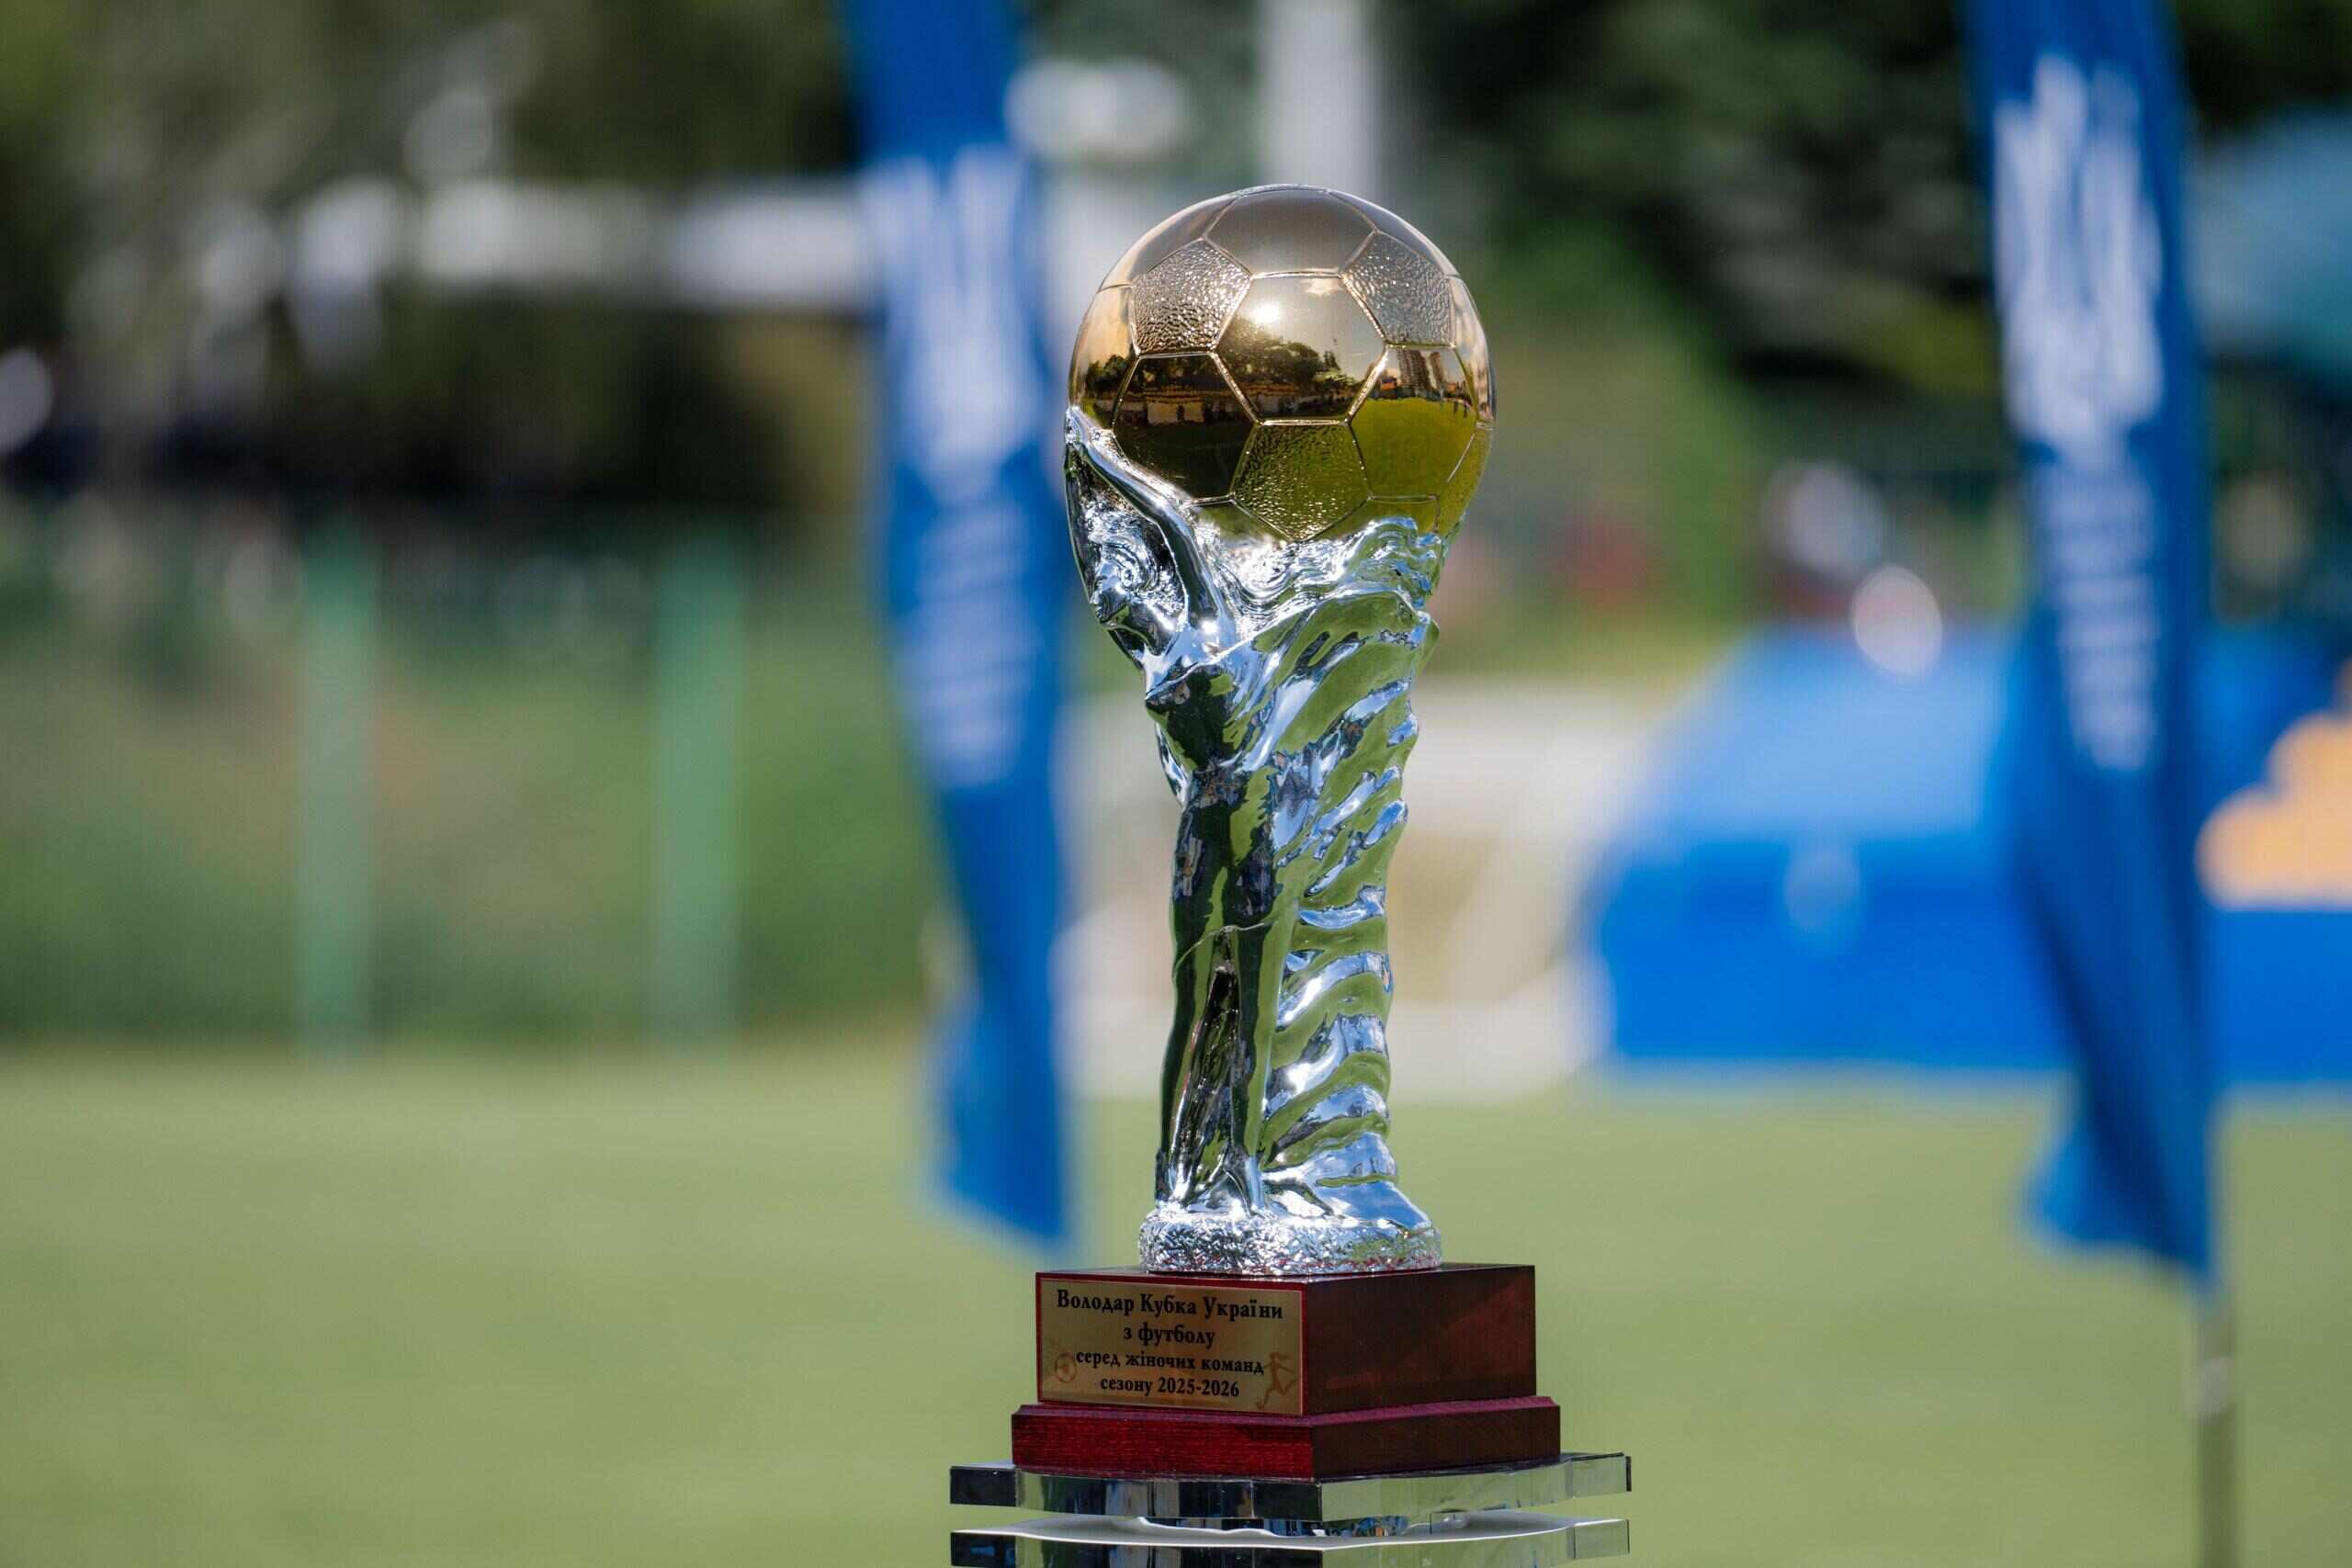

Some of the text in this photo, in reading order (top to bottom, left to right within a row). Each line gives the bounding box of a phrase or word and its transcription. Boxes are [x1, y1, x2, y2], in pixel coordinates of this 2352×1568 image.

[1057, 1289, 1283, 1322] Володар Кубка України
[1124, 1322, 1216, 1349] з футболу
[1076, 1350, 1264, 1375] серед жіночих команд
[1101, 1377, 1240, 1397] сезону 2025-2026
